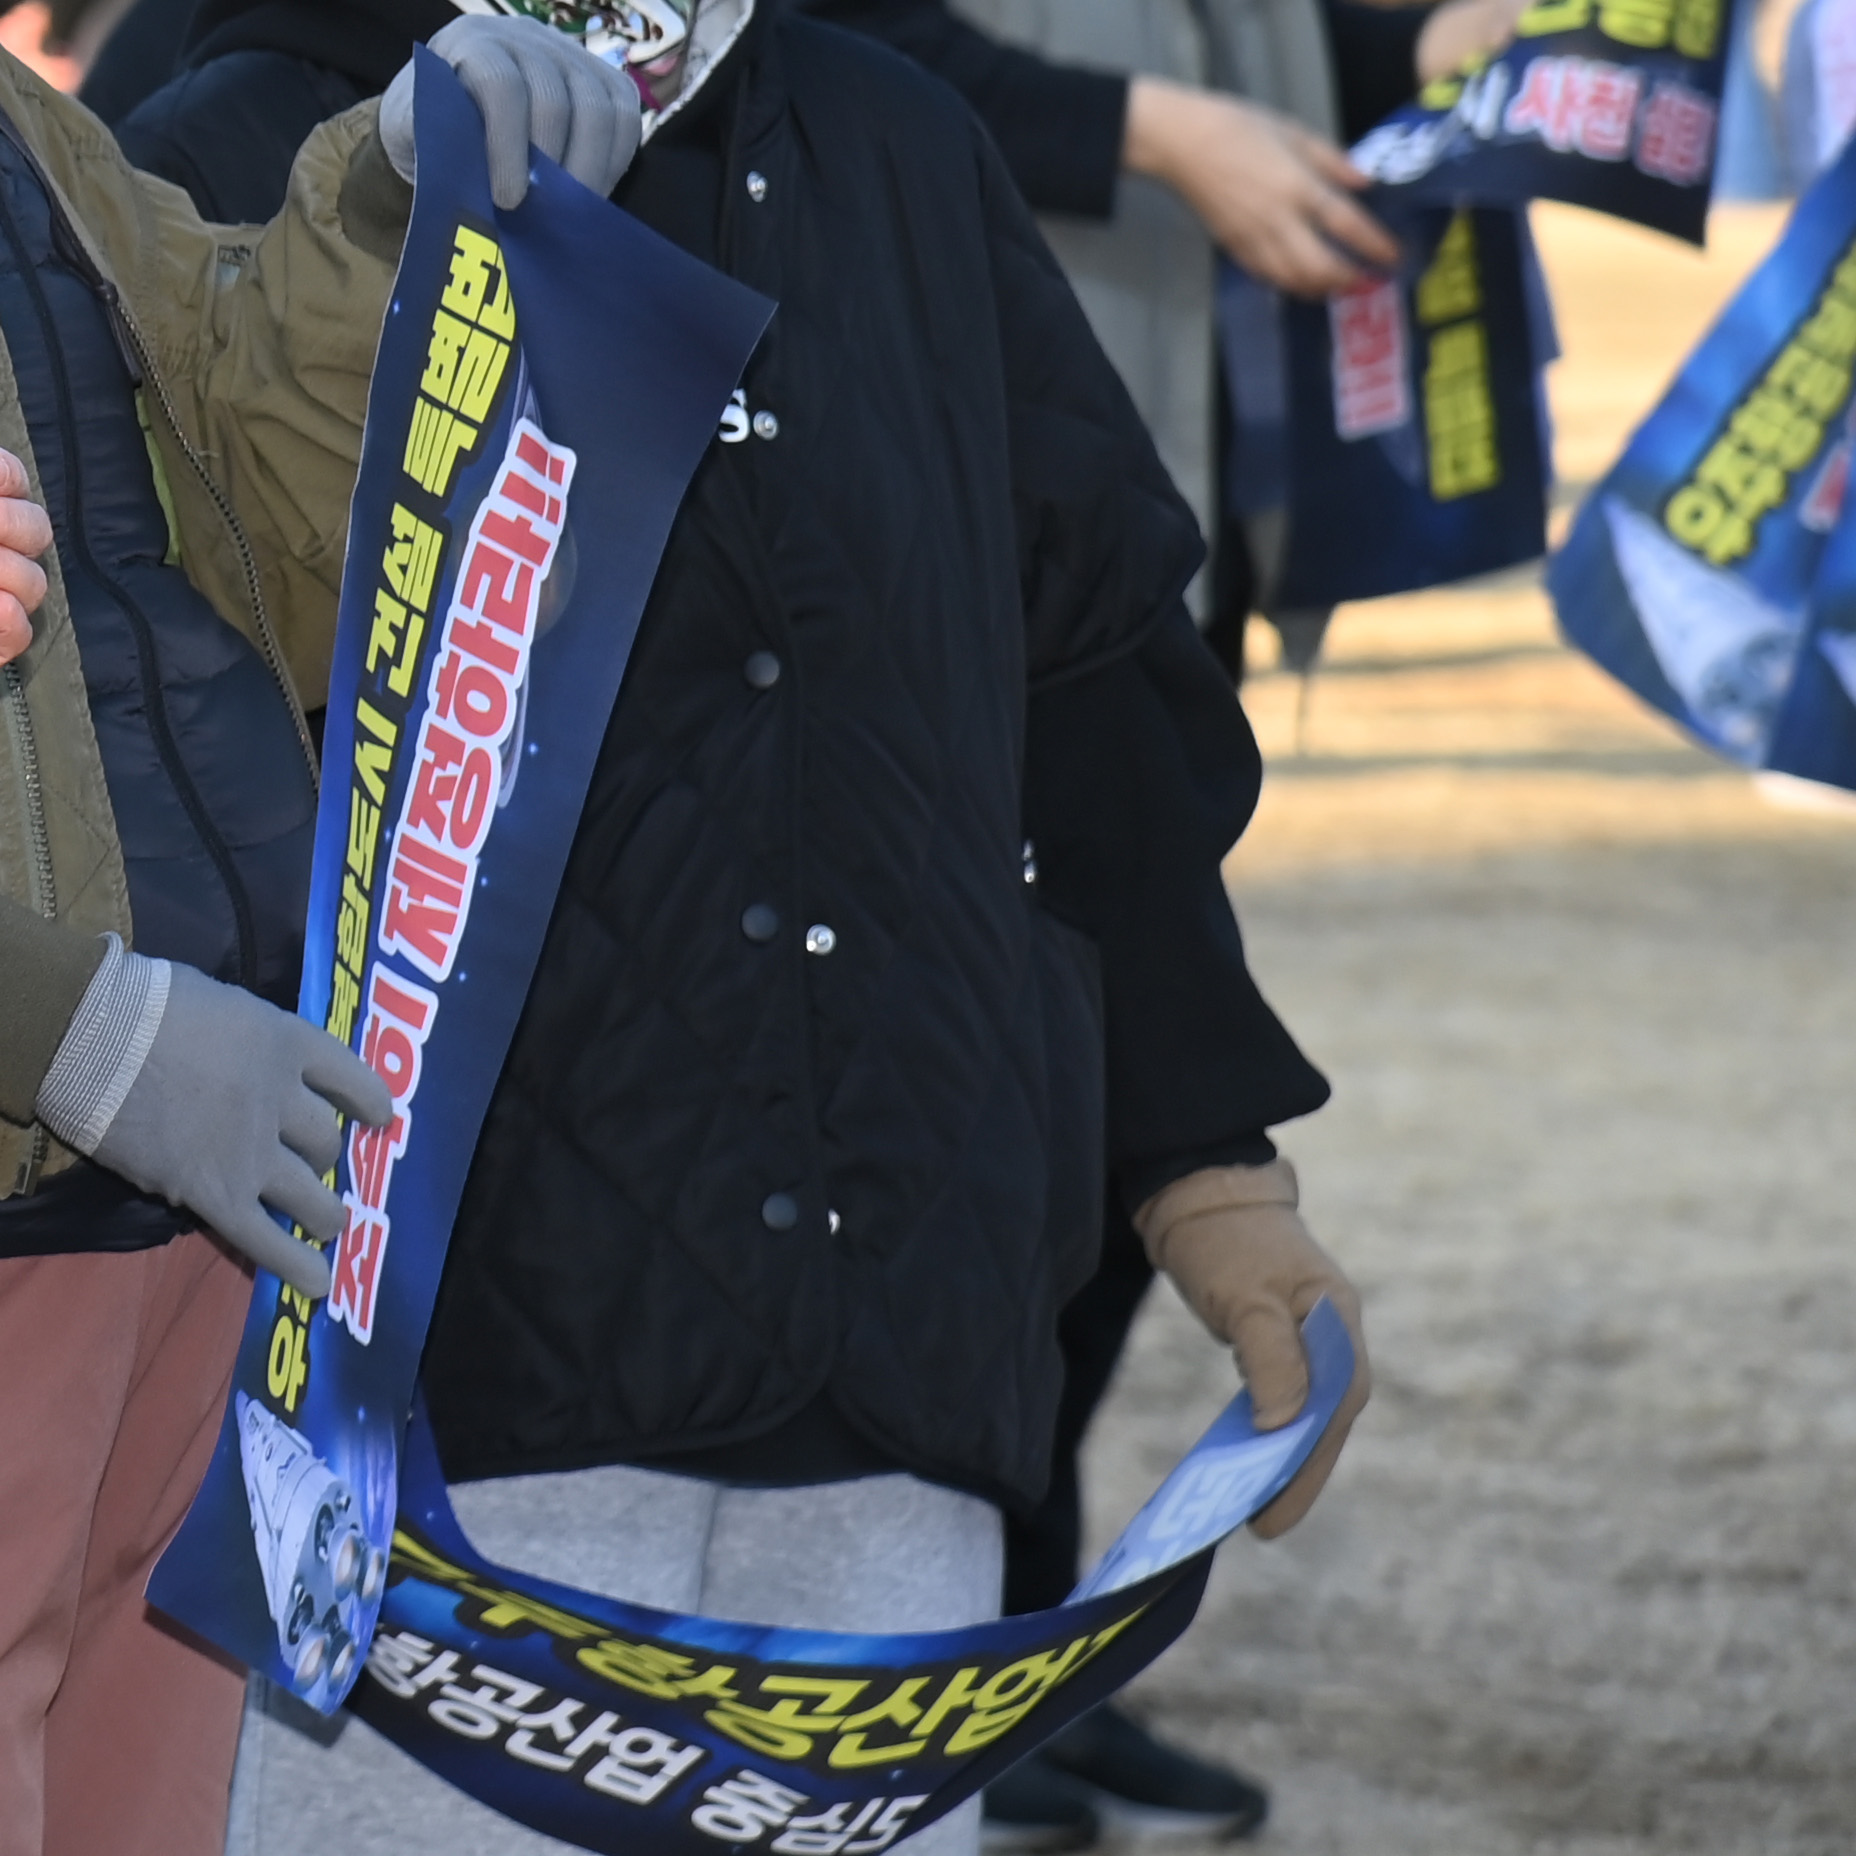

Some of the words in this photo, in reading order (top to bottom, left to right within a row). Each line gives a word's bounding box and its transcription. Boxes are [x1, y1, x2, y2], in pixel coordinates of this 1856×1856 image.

[402, 224, 517, 498] 특별법
[367, 499, 447, 698] 건설
[381, 430, 567, 968] 제정하라!!
